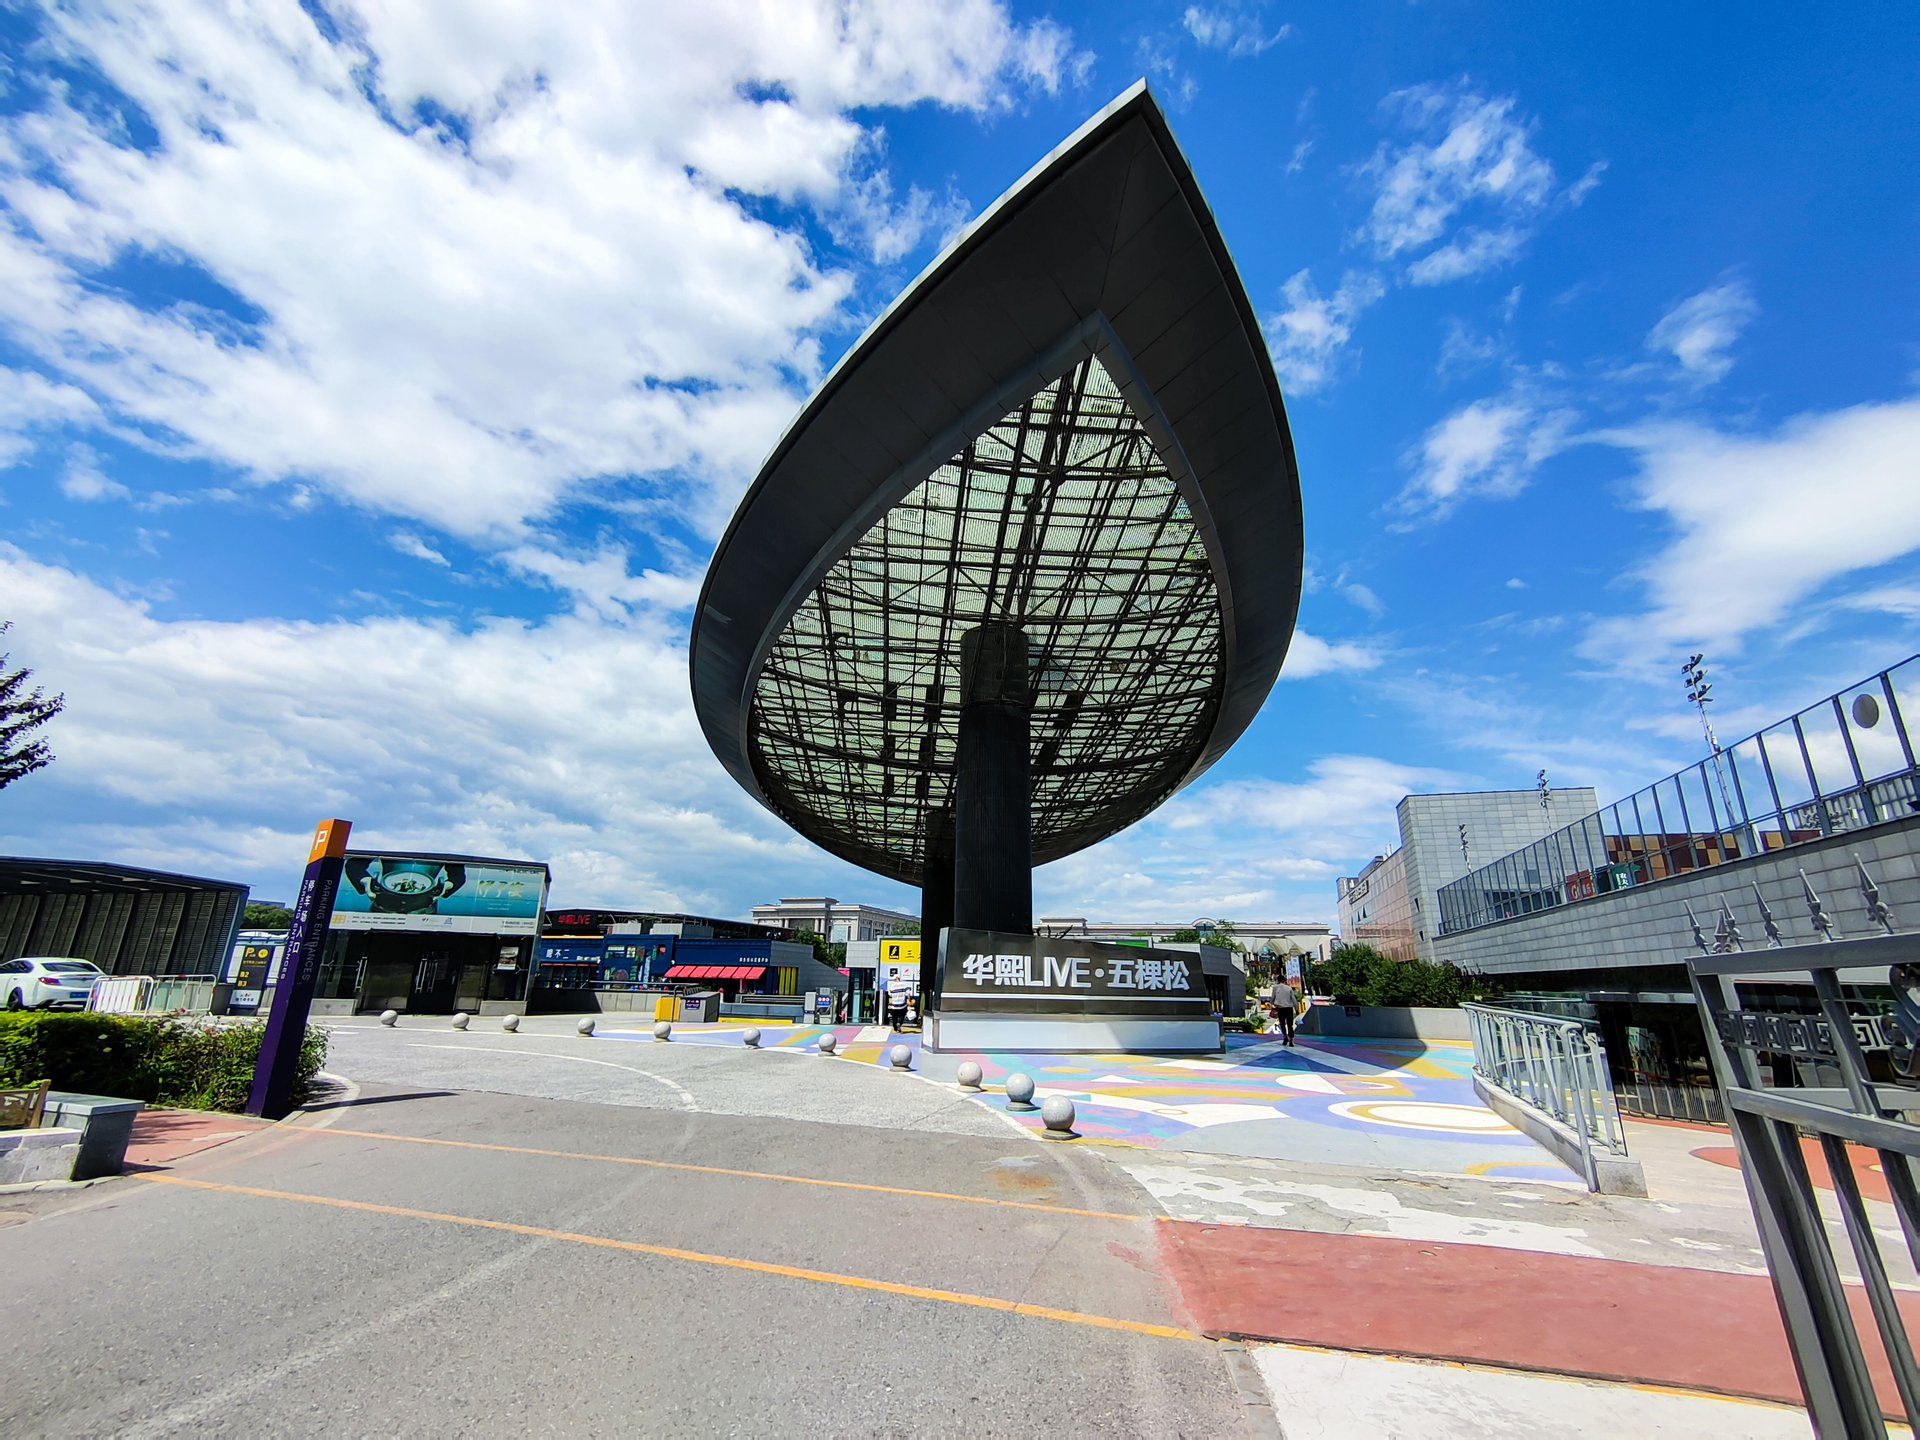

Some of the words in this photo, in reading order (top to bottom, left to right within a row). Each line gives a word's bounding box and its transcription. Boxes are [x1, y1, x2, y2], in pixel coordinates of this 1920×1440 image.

[314, 829, 328, 851] P
[295, 879, 309, 919] PARKING
[316, 879, 333, 920] PARKING
[280, 923, 299, 980] ENTRANCES
[301, 923, 323, 981] ENTRANCES
[962, 953, 1190, 991] 华熙LIVE·五棵松
